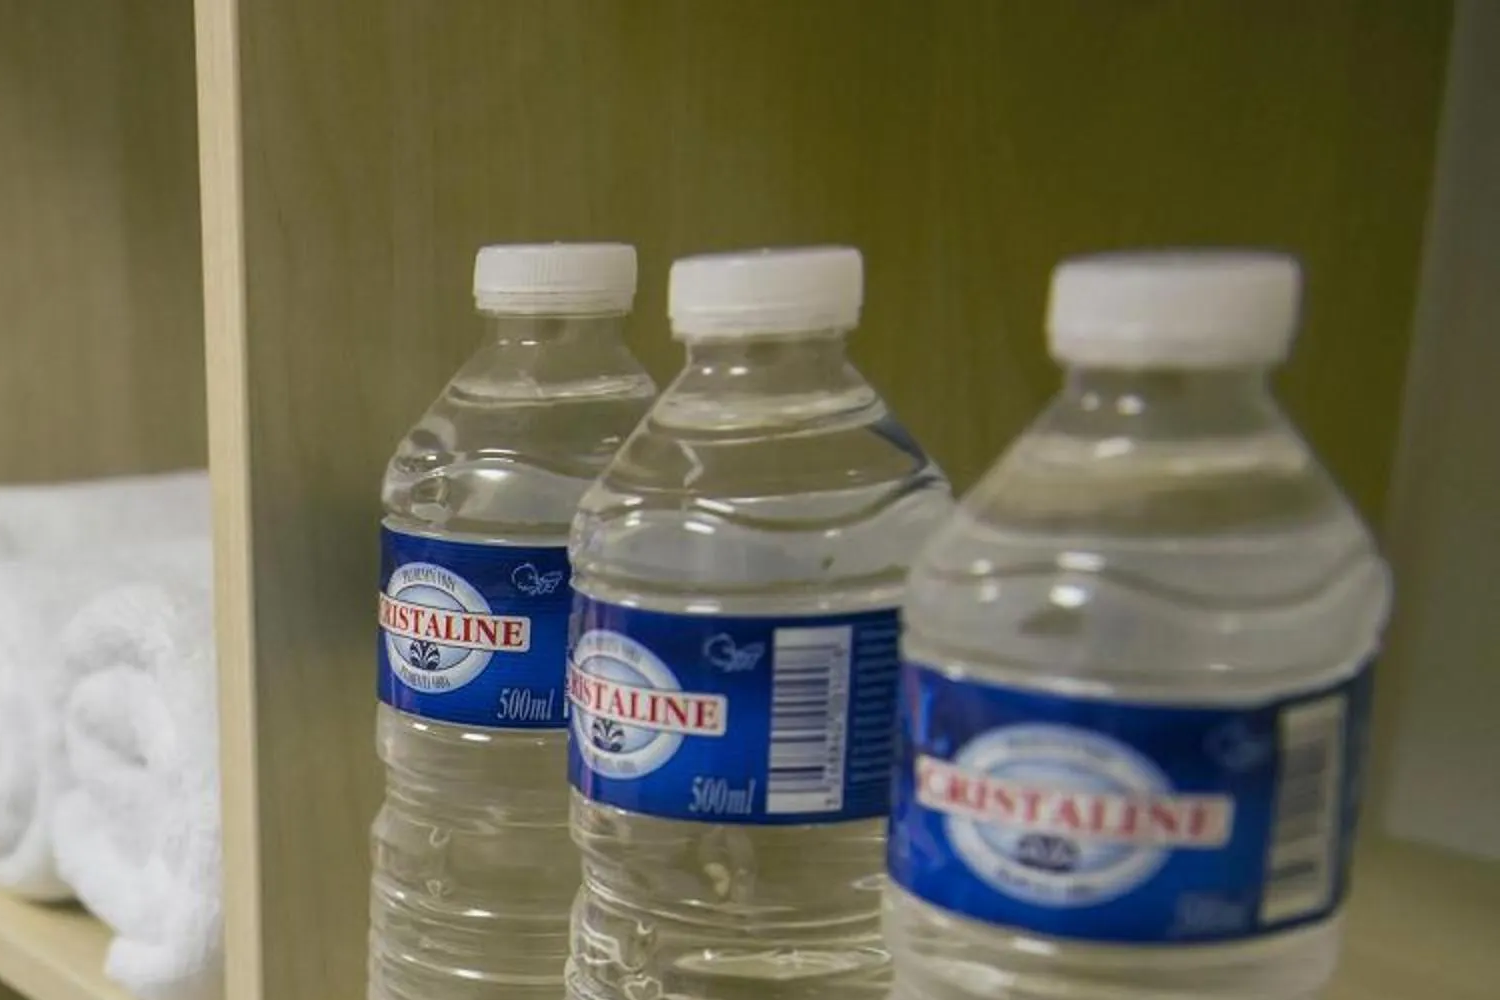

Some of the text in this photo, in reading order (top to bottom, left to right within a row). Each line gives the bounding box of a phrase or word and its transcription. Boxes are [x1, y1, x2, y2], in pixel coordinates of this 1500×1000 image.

[380, 598, 523, 647] RISTALINE
[497, 689, 555, 720] 500ml
[568, 668, 719, 731] RISTALINE
[688, 777, 756, 814] 500ml
[919, 765, 1212, 839] CRISTALINE
